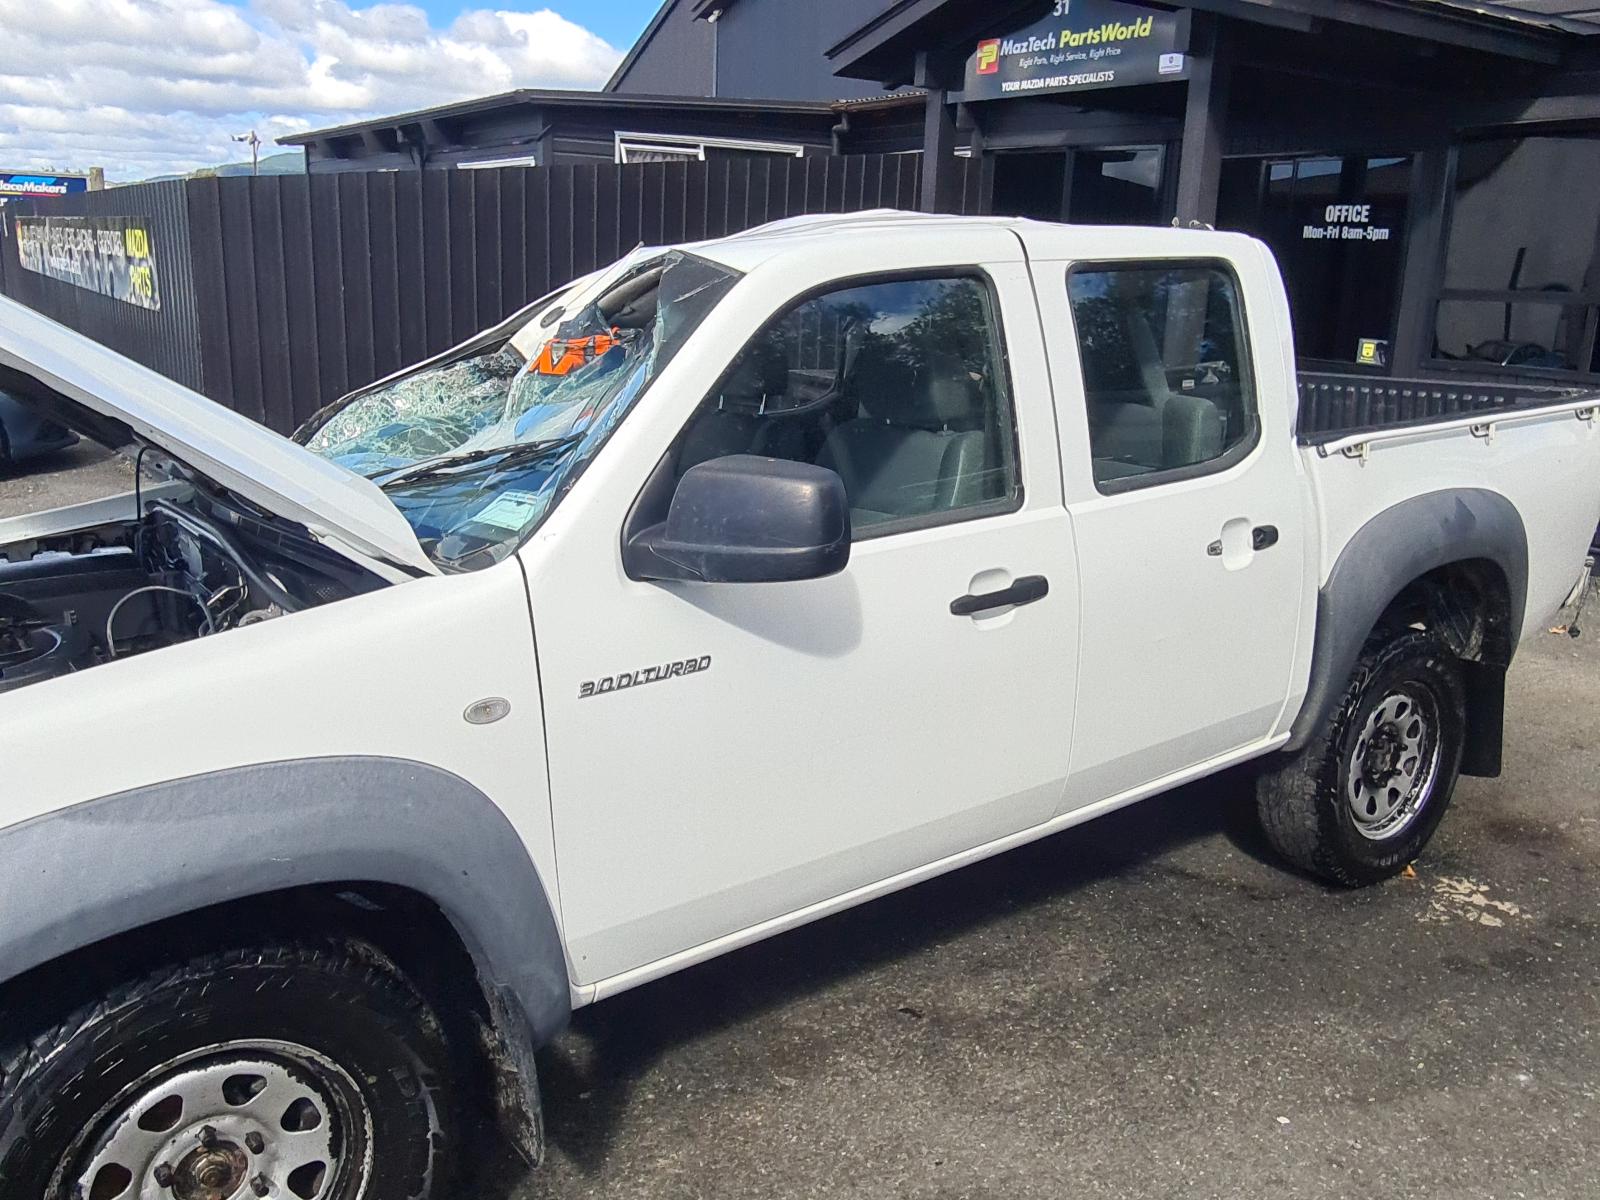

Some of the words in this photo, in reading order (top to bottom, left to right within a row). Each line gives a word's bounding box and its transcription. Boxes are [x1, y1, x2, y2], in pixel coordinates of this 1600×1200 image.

[1053, 0, 1068, 16] 31
[1000, 32, 1055, 56] MazTech
[1059, 16, 1153, 48] PartsWorld
[1049, 54, 1065, 65] Right
[1089, 48, 1105, 59] Right
[1001, 81, 1020, 92] YOUR
[1021, 79, 1044, 90] MAZDA
[1044, 75, 1068, 87] PARTS
[1068, 70, 1115, 85] SPECIALISTS
[0, 180, 67, 194] laceMakers
[1325, 204, 1370, 222] OFFICE
[1303, 226, 1340, 239] Mon-Fri
[1341, 226, 1389, 241] 8am-5pm
